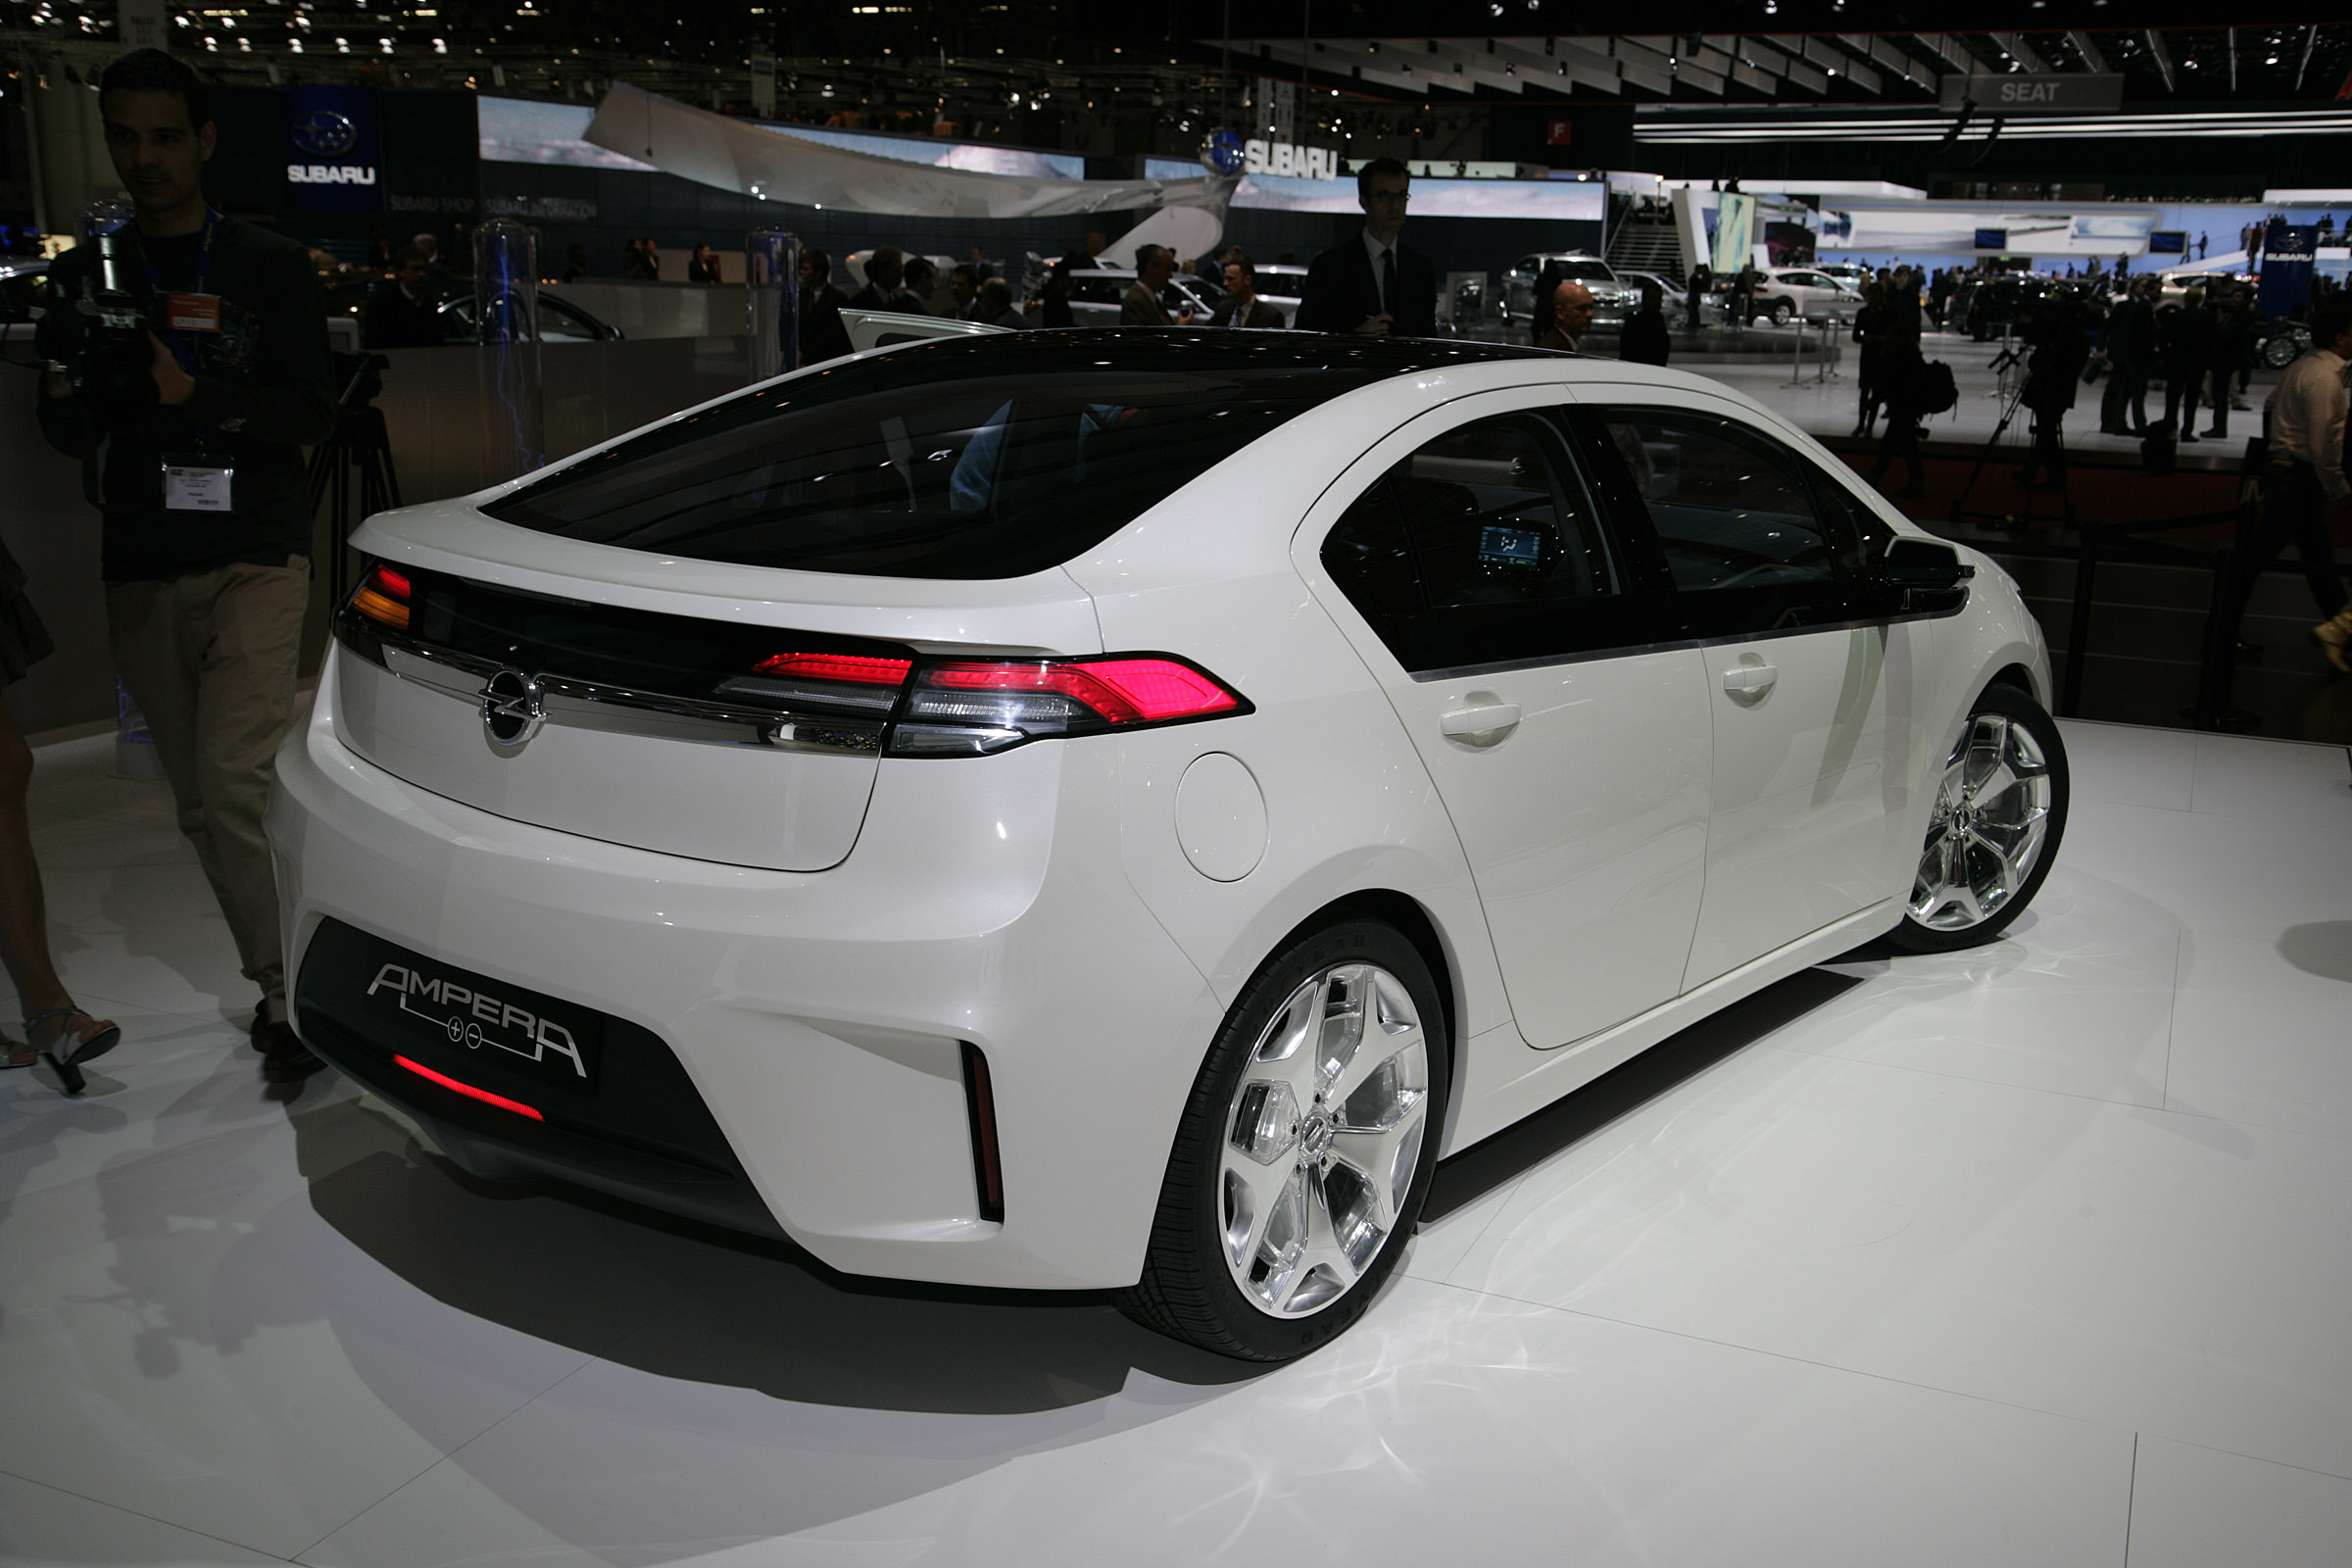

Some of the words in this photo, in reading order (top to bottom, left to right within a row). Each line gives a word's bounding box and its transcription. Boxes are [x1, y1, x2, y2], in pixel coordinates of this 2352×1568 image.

[2000, 82, 2061, 102] SEAT
[1553, 122, 1567, 138] F
[1244, 139, 1339, 180] SUBARU
[287, 165, 375, 185] SUBARU
[389, 195, 438, 212] SUBARU
[2265, 252, 2314, 263] SUBARU
[366, 962, 588, 1079] AMPERA
